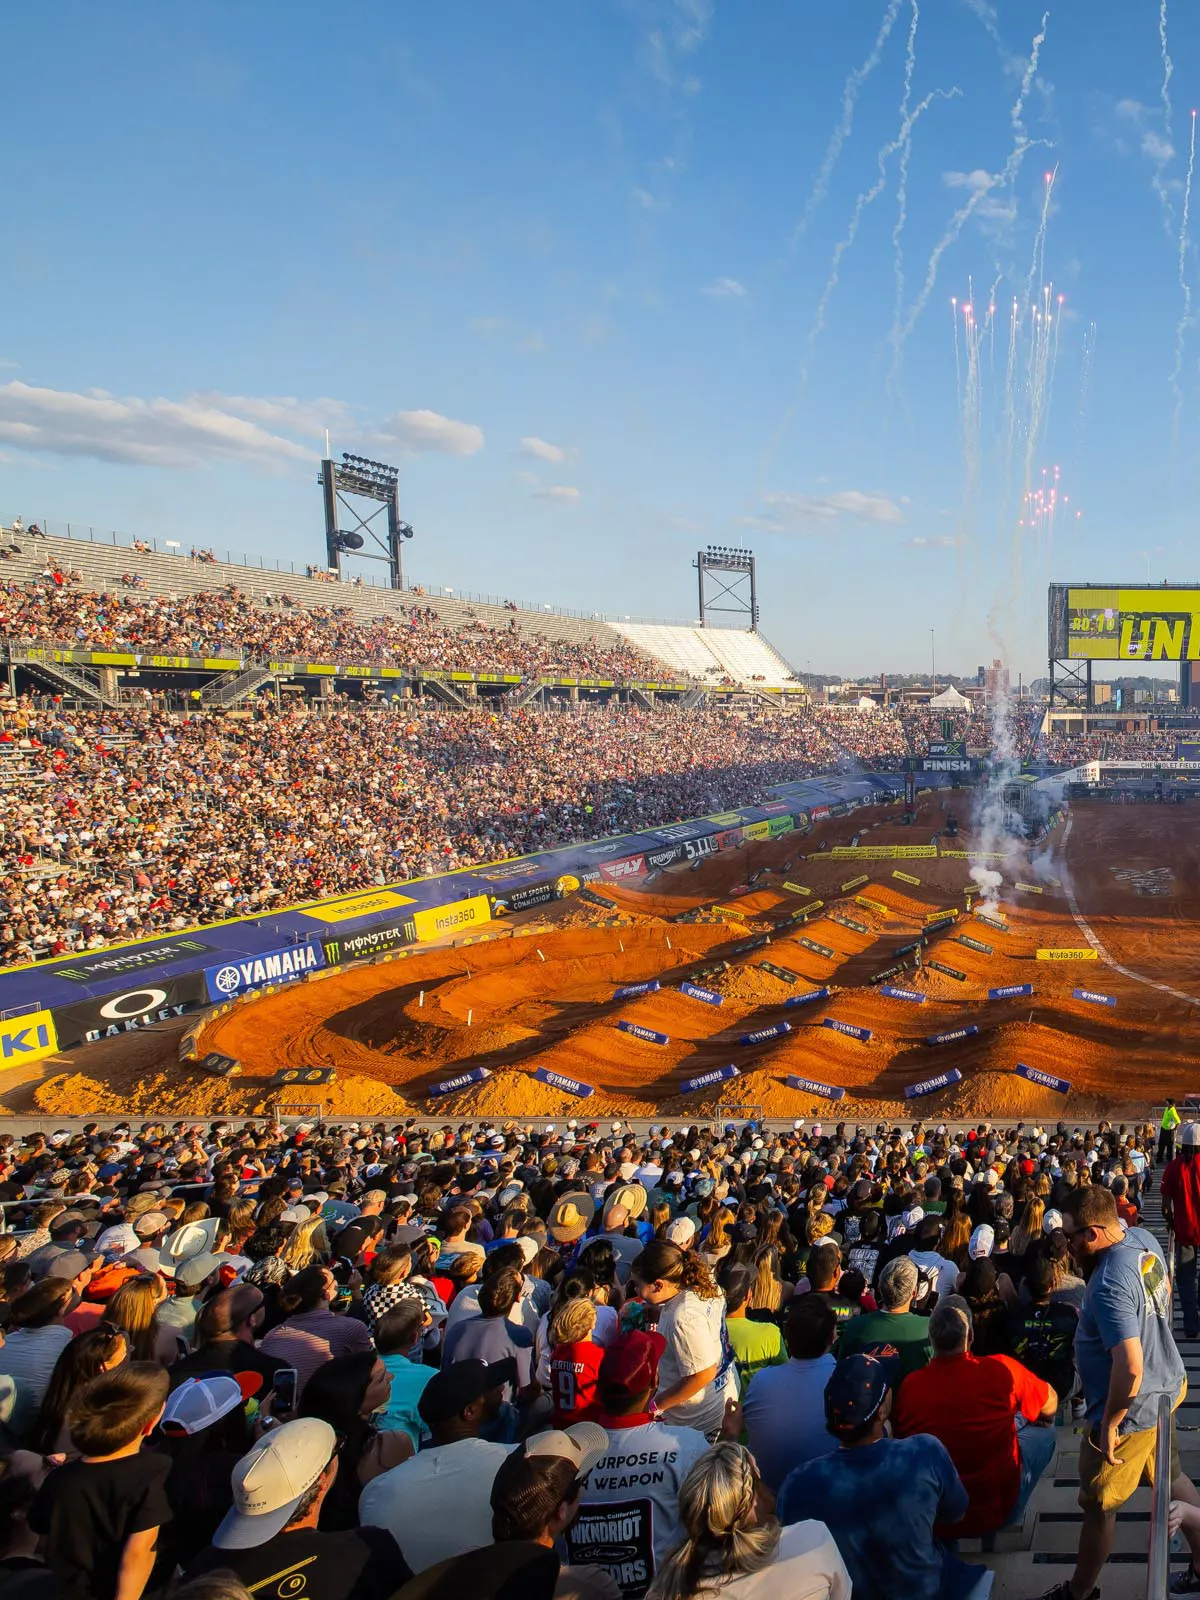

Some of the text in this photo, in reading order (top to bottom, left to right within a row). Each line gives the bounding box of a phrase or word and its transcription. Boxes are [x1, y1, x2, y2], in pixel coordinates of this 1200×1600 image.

[923, 760, 971, 771] FINISH
[436, 907, 475, 929] Insta360
[344, 927, 401, 952] MONSTER
[354, 940, 395, 957] ENERGY
[86, 945, 180, 972] MONSTER
[240, 945, 317, 985] YAMAHA
[85, 1003, 187, 1042] OAKLEY
[837, 1022, 861, 1036] YAMAHA
[2, 1024, 50, 1057] KI
[554, 1075, 580, 1091] YAMAHA
[696, 1068, 723, 1086] YAMAHA
[1034, 1071, 1059, 1087] YAMAHA
[804, 1079, 832, 1095] YAMAHA
[558, 1372, 575, 1410] 9
[597, 1452, 677, 1469] URPOSE IS
[595, 1471, 665, 1490] WEAPON
[571, 1516, 643, 1544] WKNDRIOT
